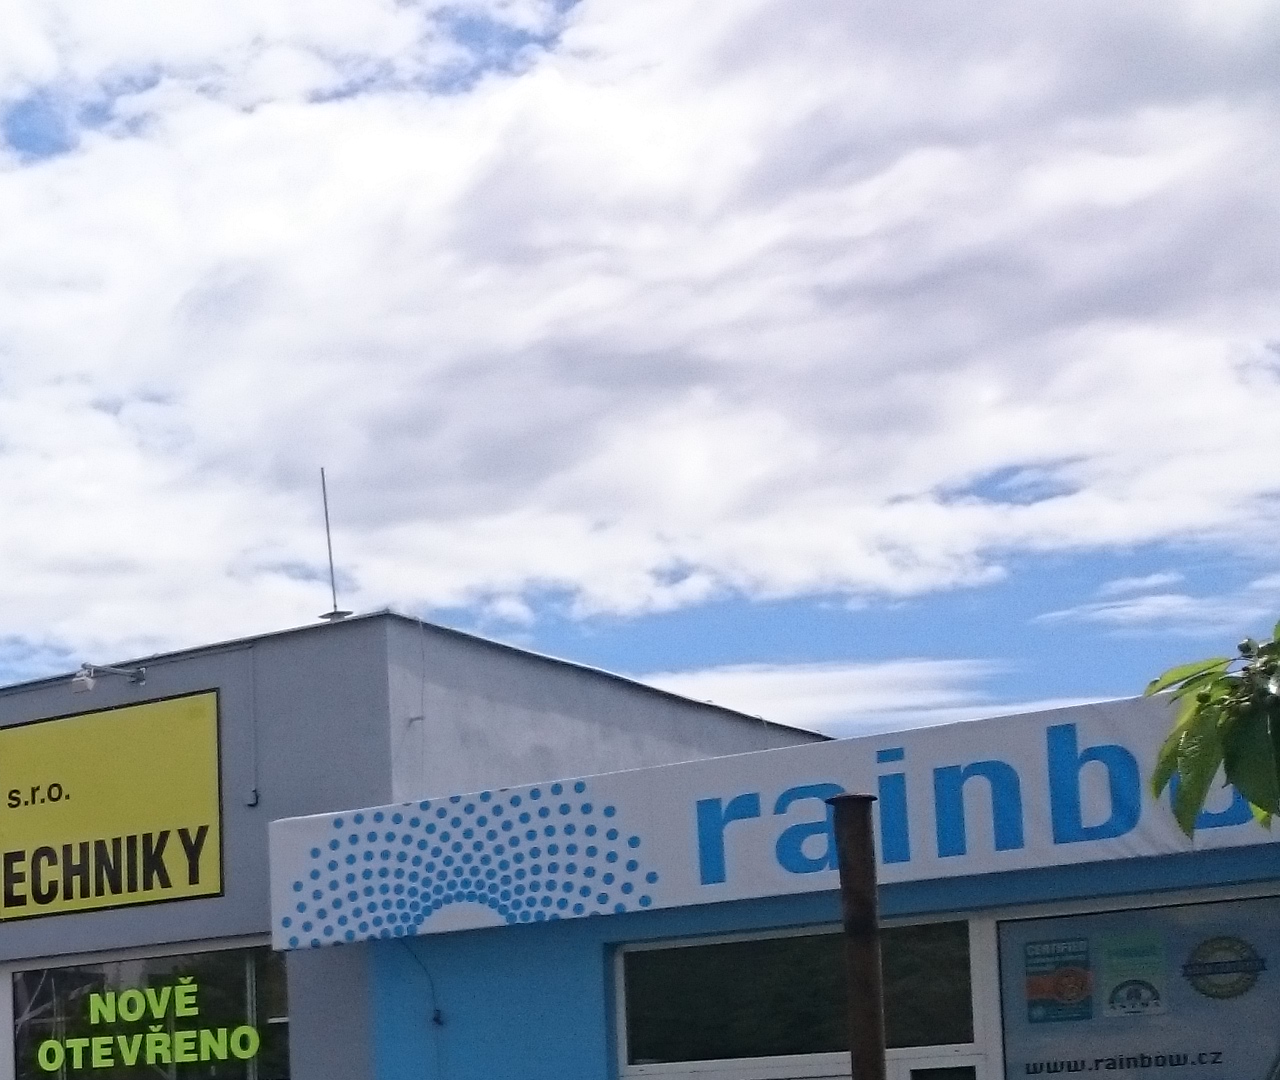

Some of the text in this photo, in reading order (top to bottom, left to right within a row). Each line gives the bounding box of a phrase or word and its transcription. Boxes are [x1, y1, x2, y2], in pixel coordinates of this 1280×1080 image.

[7, 782, 71, 809] s.r.o.
[90, 975, 199, 1025] NOVĚ
[38, 1024, 260, 1072] OTEVŘENO
[1025, 1051, 1223, 1075] www.rainbow.cz
